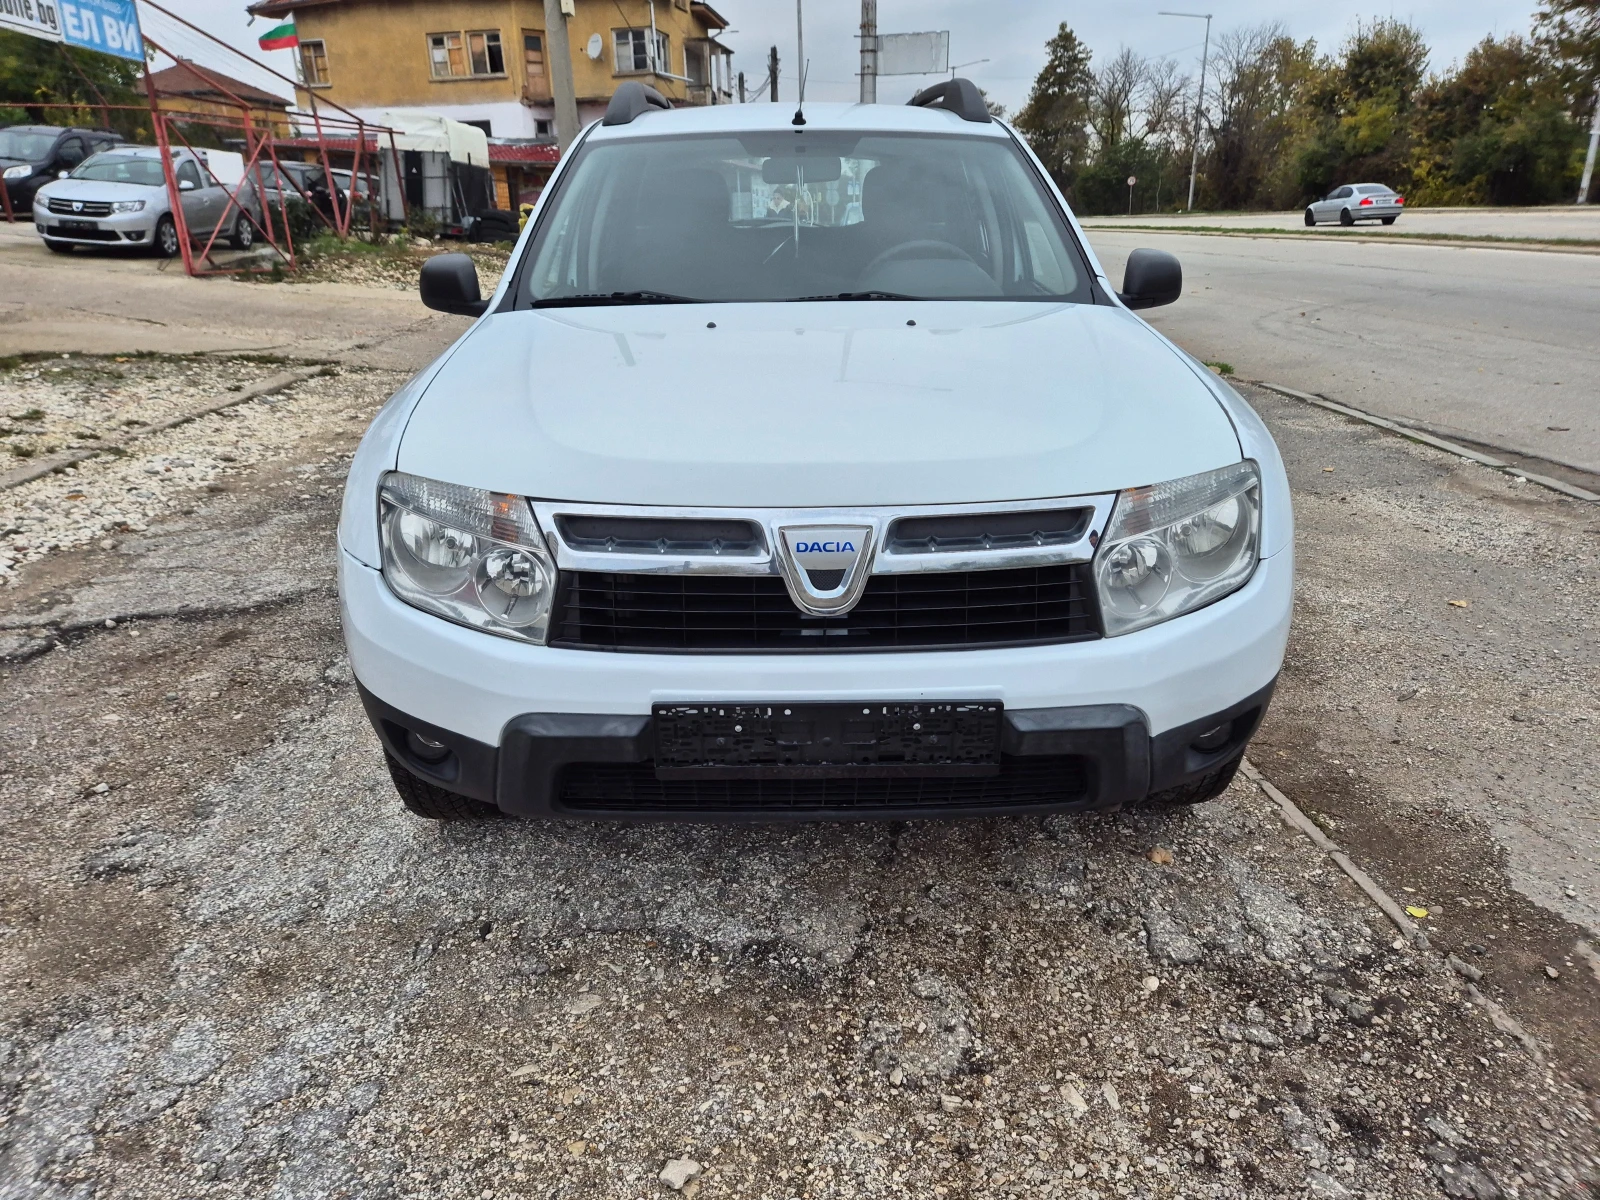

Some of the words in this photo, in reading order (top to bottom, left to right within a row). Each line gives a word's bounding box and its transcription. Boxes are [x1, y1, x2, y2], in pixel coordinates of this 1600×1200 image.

[62, 2, 100, 44] ЕЛ
[102, 14, 140, 54] ВИ
[796, 541, 855, 553] DACIA
